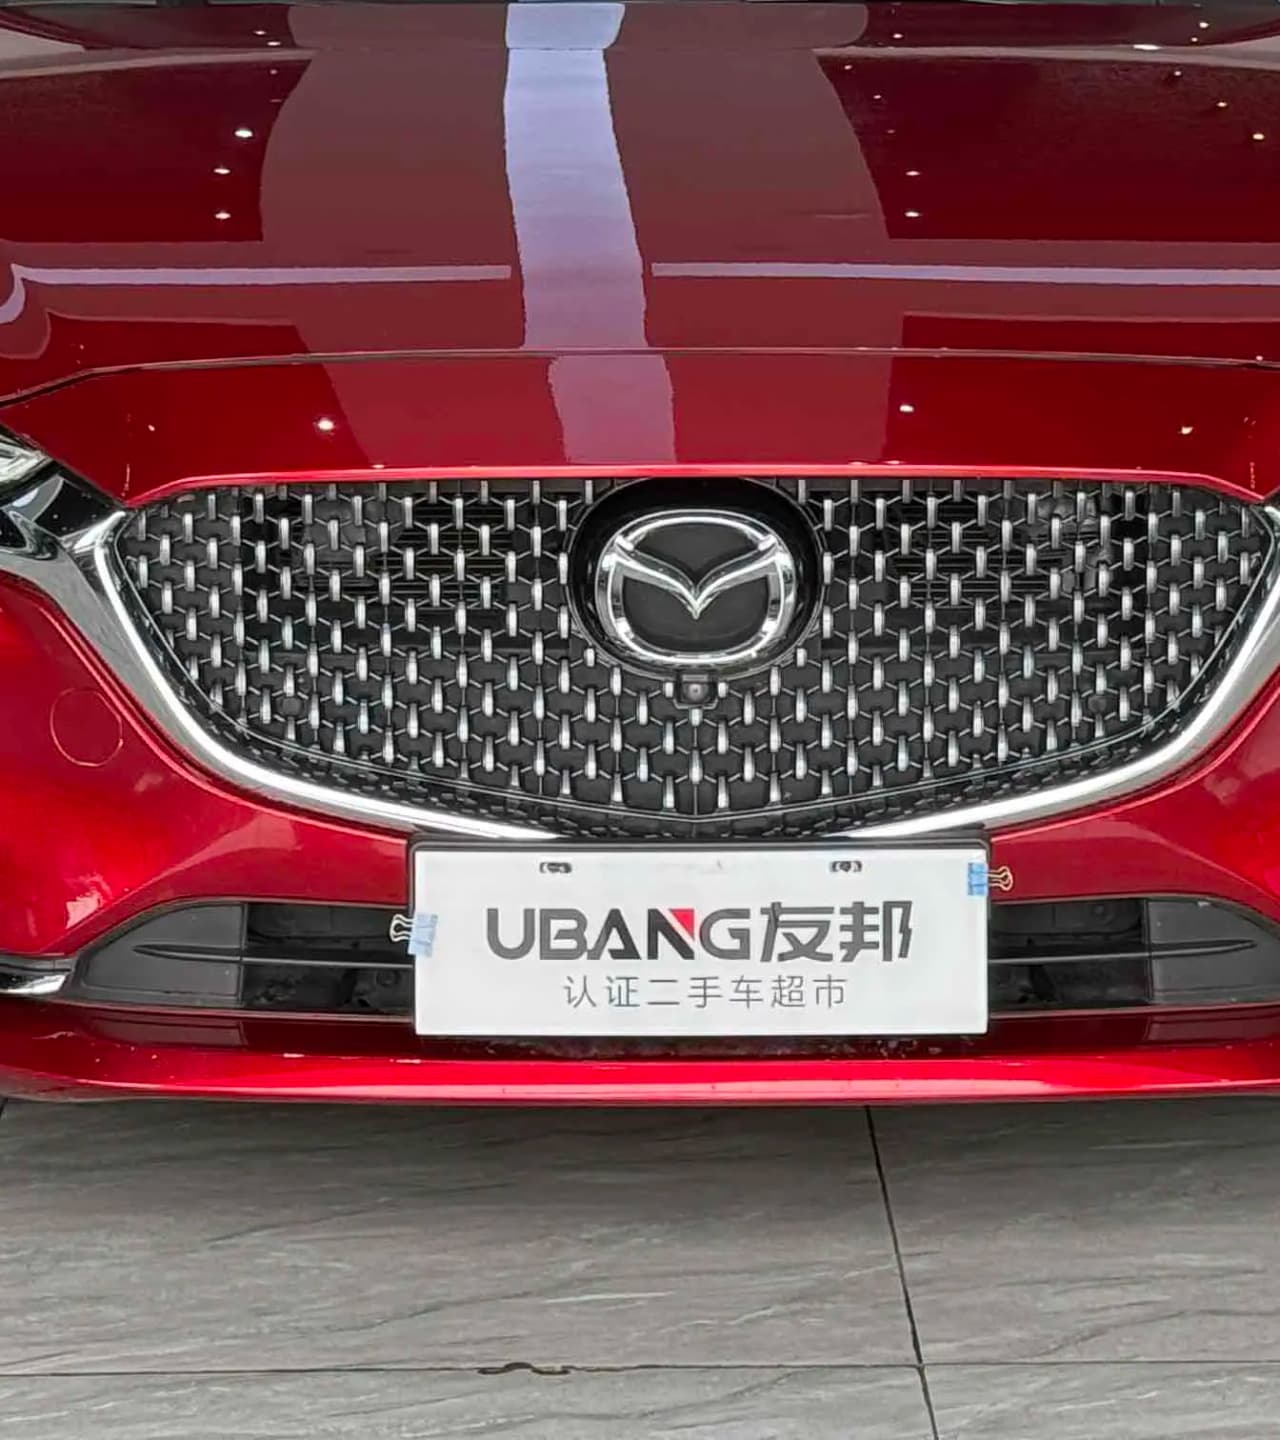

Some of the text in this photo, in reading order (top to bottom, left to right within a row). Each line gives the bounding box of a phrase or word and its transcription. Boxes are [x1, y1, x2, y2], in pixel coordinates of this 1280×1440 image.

[485, 900, 913, 962] UBANG友邦
[562, 975, 848, 1009] 认证二手车超市
